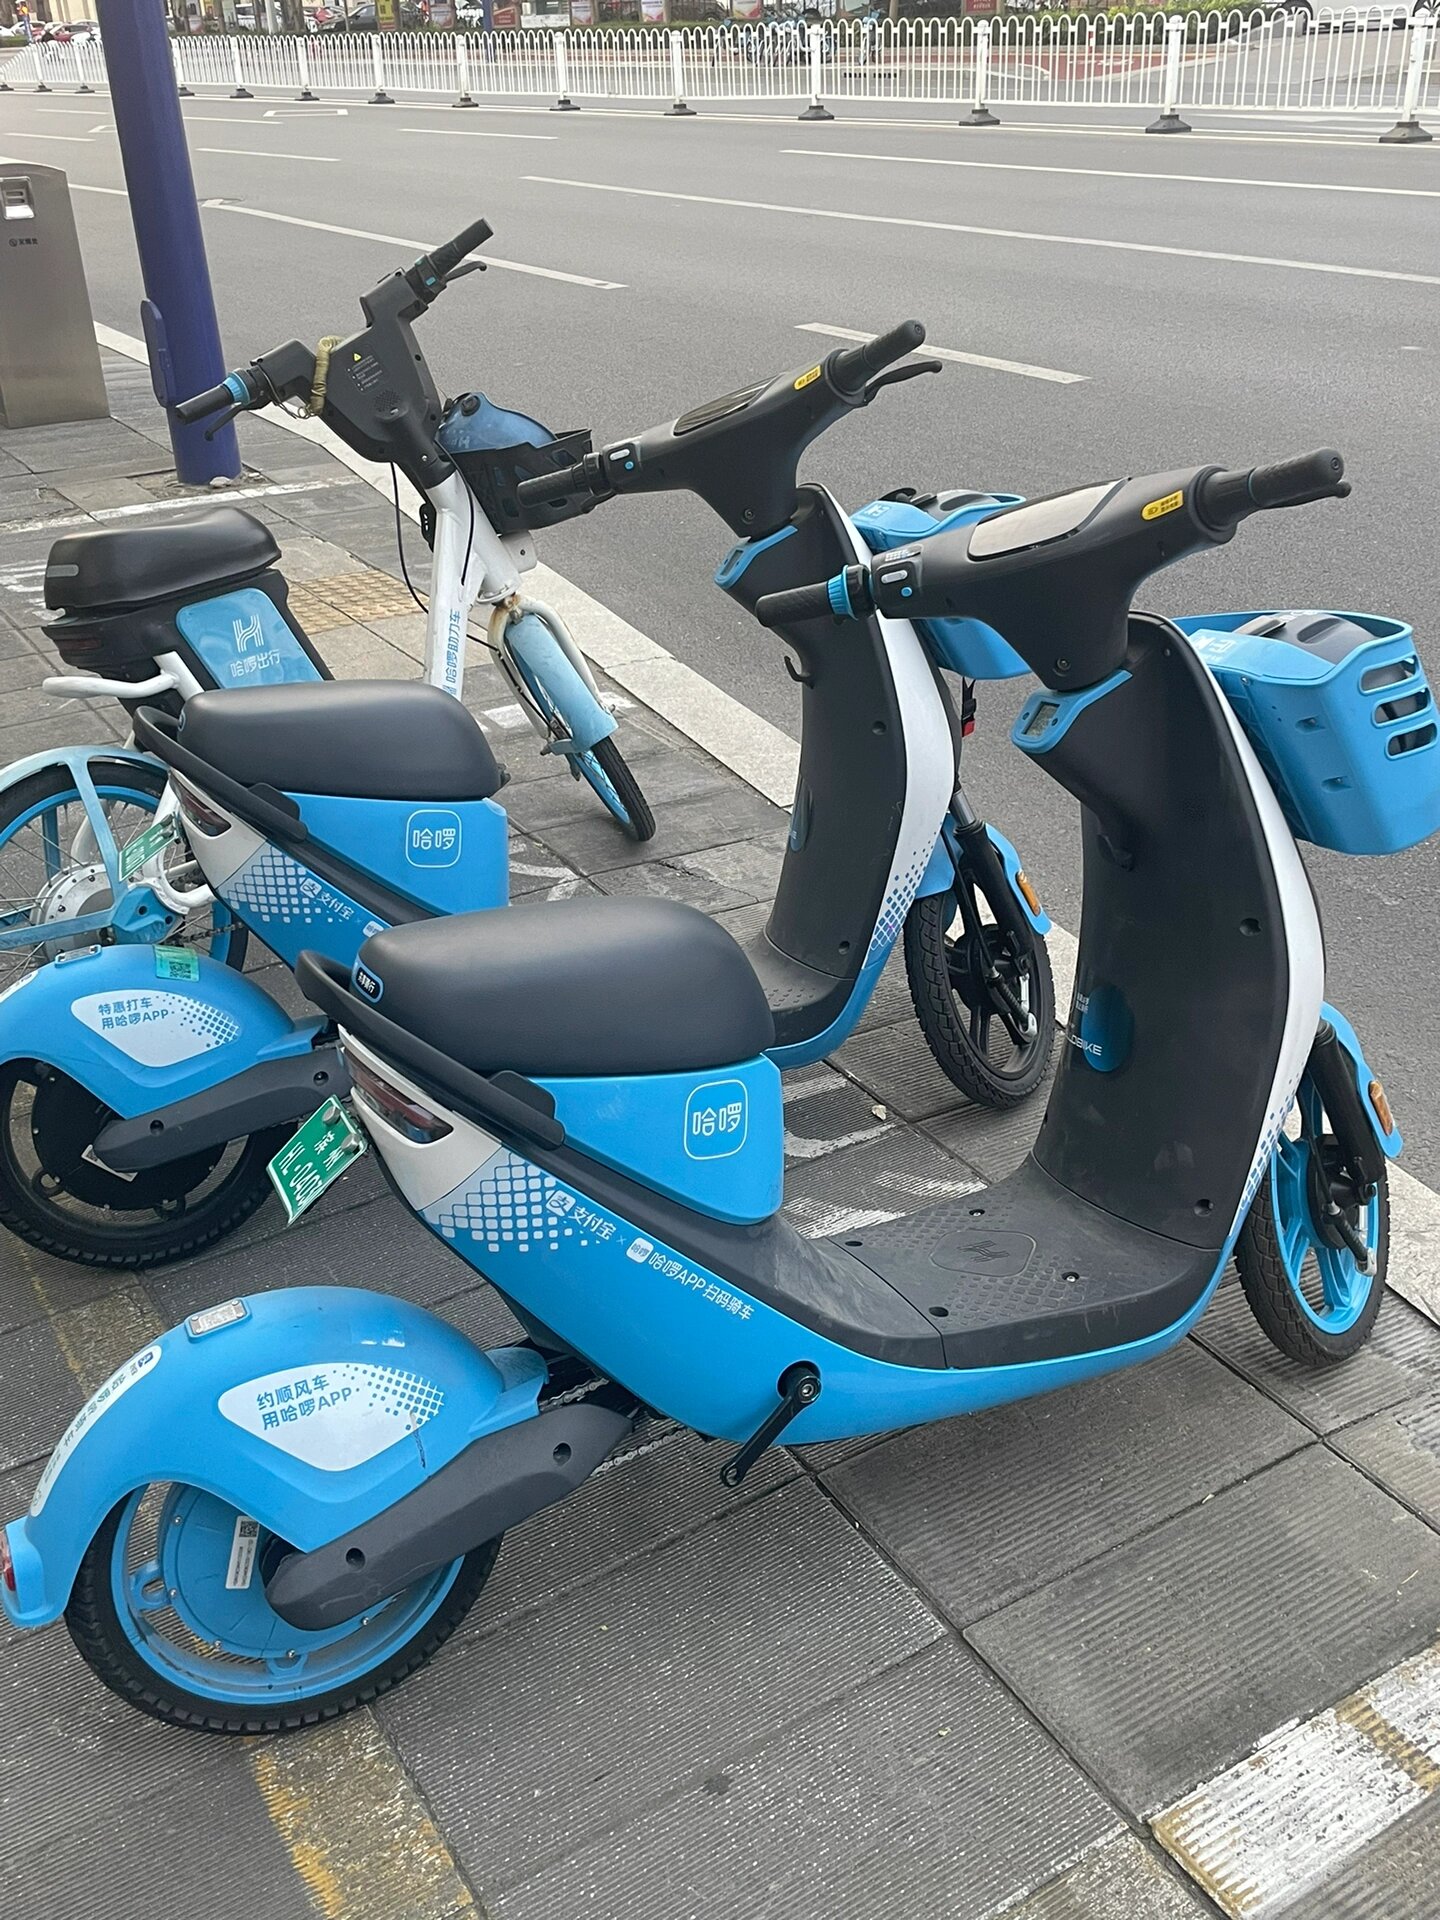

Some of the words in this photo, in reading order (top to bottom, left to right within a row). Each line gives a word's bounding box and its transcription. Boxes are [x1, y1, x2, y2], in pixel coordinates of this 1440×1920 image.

[445, 608, 462, 683] 哈啰助力车
[230, 648, 281, 678] 哈啰出行
[412, 827, 456, 851] 哈啰
[316, 890, 355, 921] 支付宝
[98, 997, 153, 1016] 特惠打车
[101, 1009, 169, 1031] 用哈啰APP
[691, 1101, 742, 1137] 哈啰
[568, 1205, 617, 1241] 支付宝
[648, 1251, 708, 1292] 哈啰APP
[702, 1282, 755, 1321] 扫码骑车
[256, 1374, 330, 1411] 约顺风车
[261, 1387, 353, 1431] 用哈啰APP
